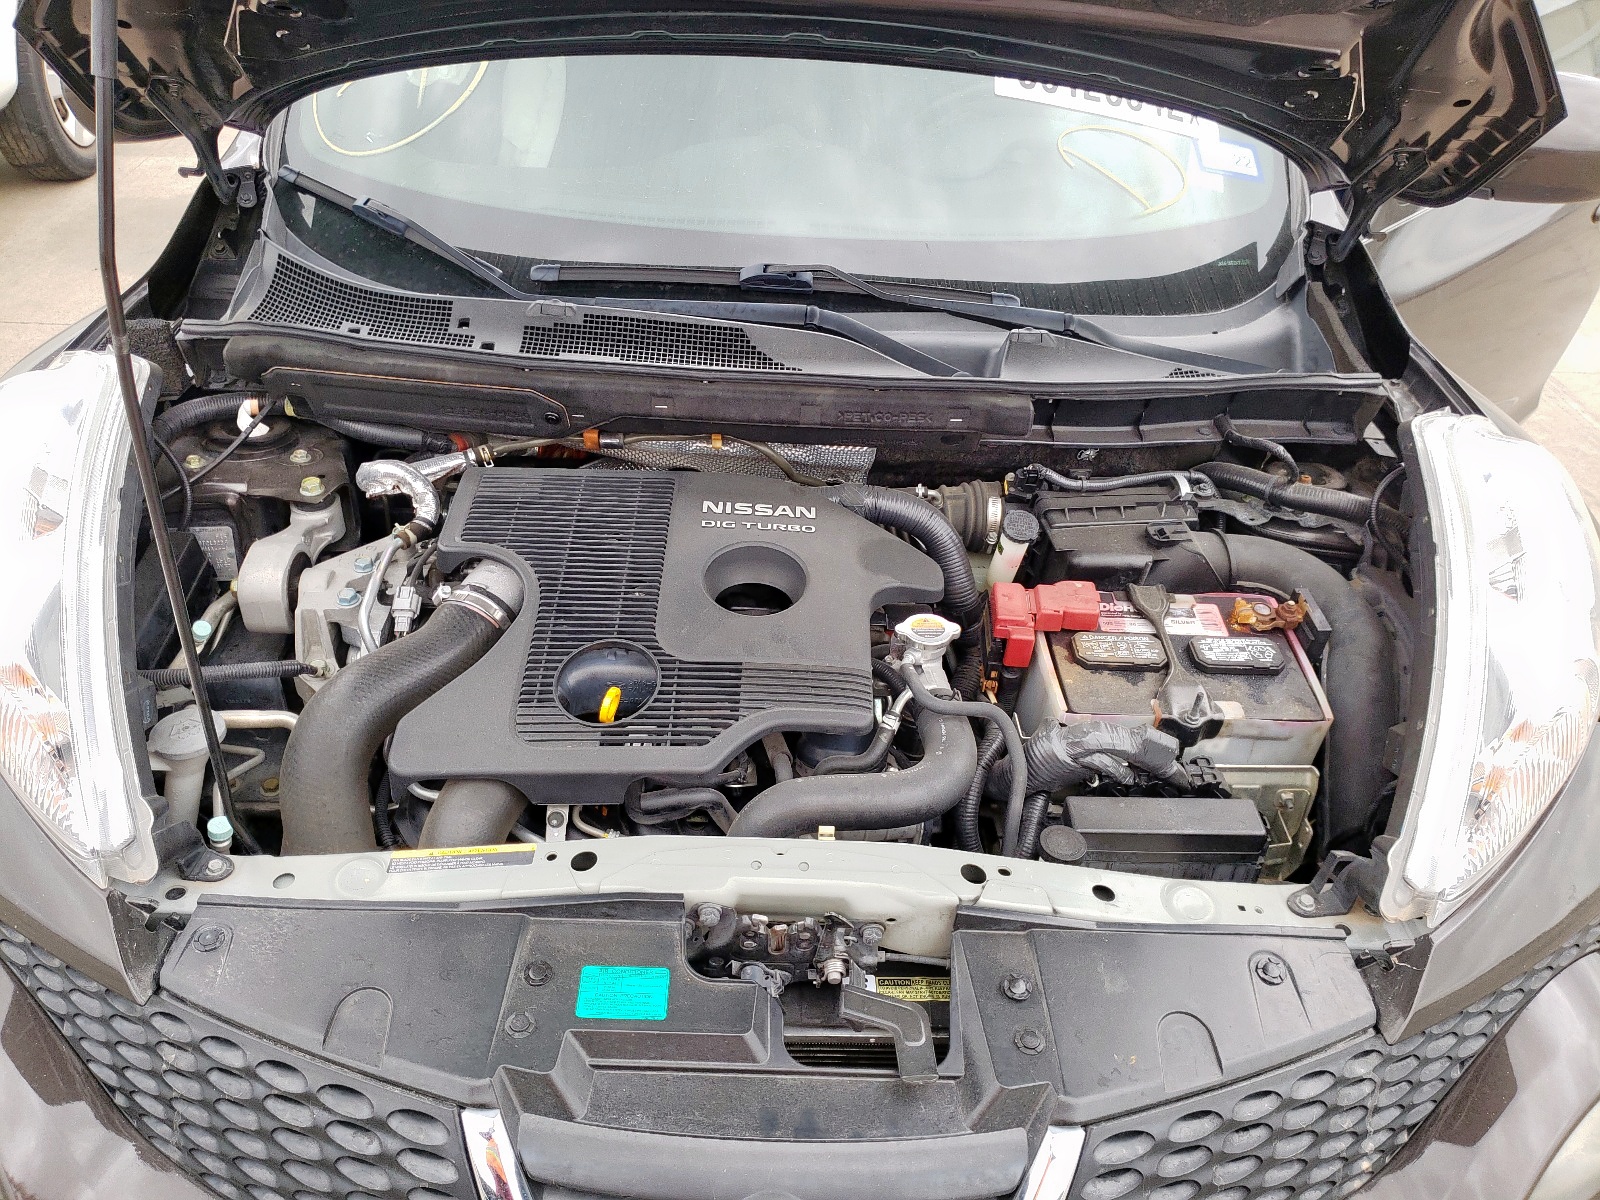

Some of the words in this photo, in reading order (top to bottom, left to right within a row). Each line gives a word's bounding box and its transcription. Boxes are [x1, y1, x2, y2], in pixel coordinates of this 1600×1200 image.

[701, 500, 817, 520] NISSAN
[700, 519, 737, 529] DIG
[741, 521, 816, 534] TURBO
